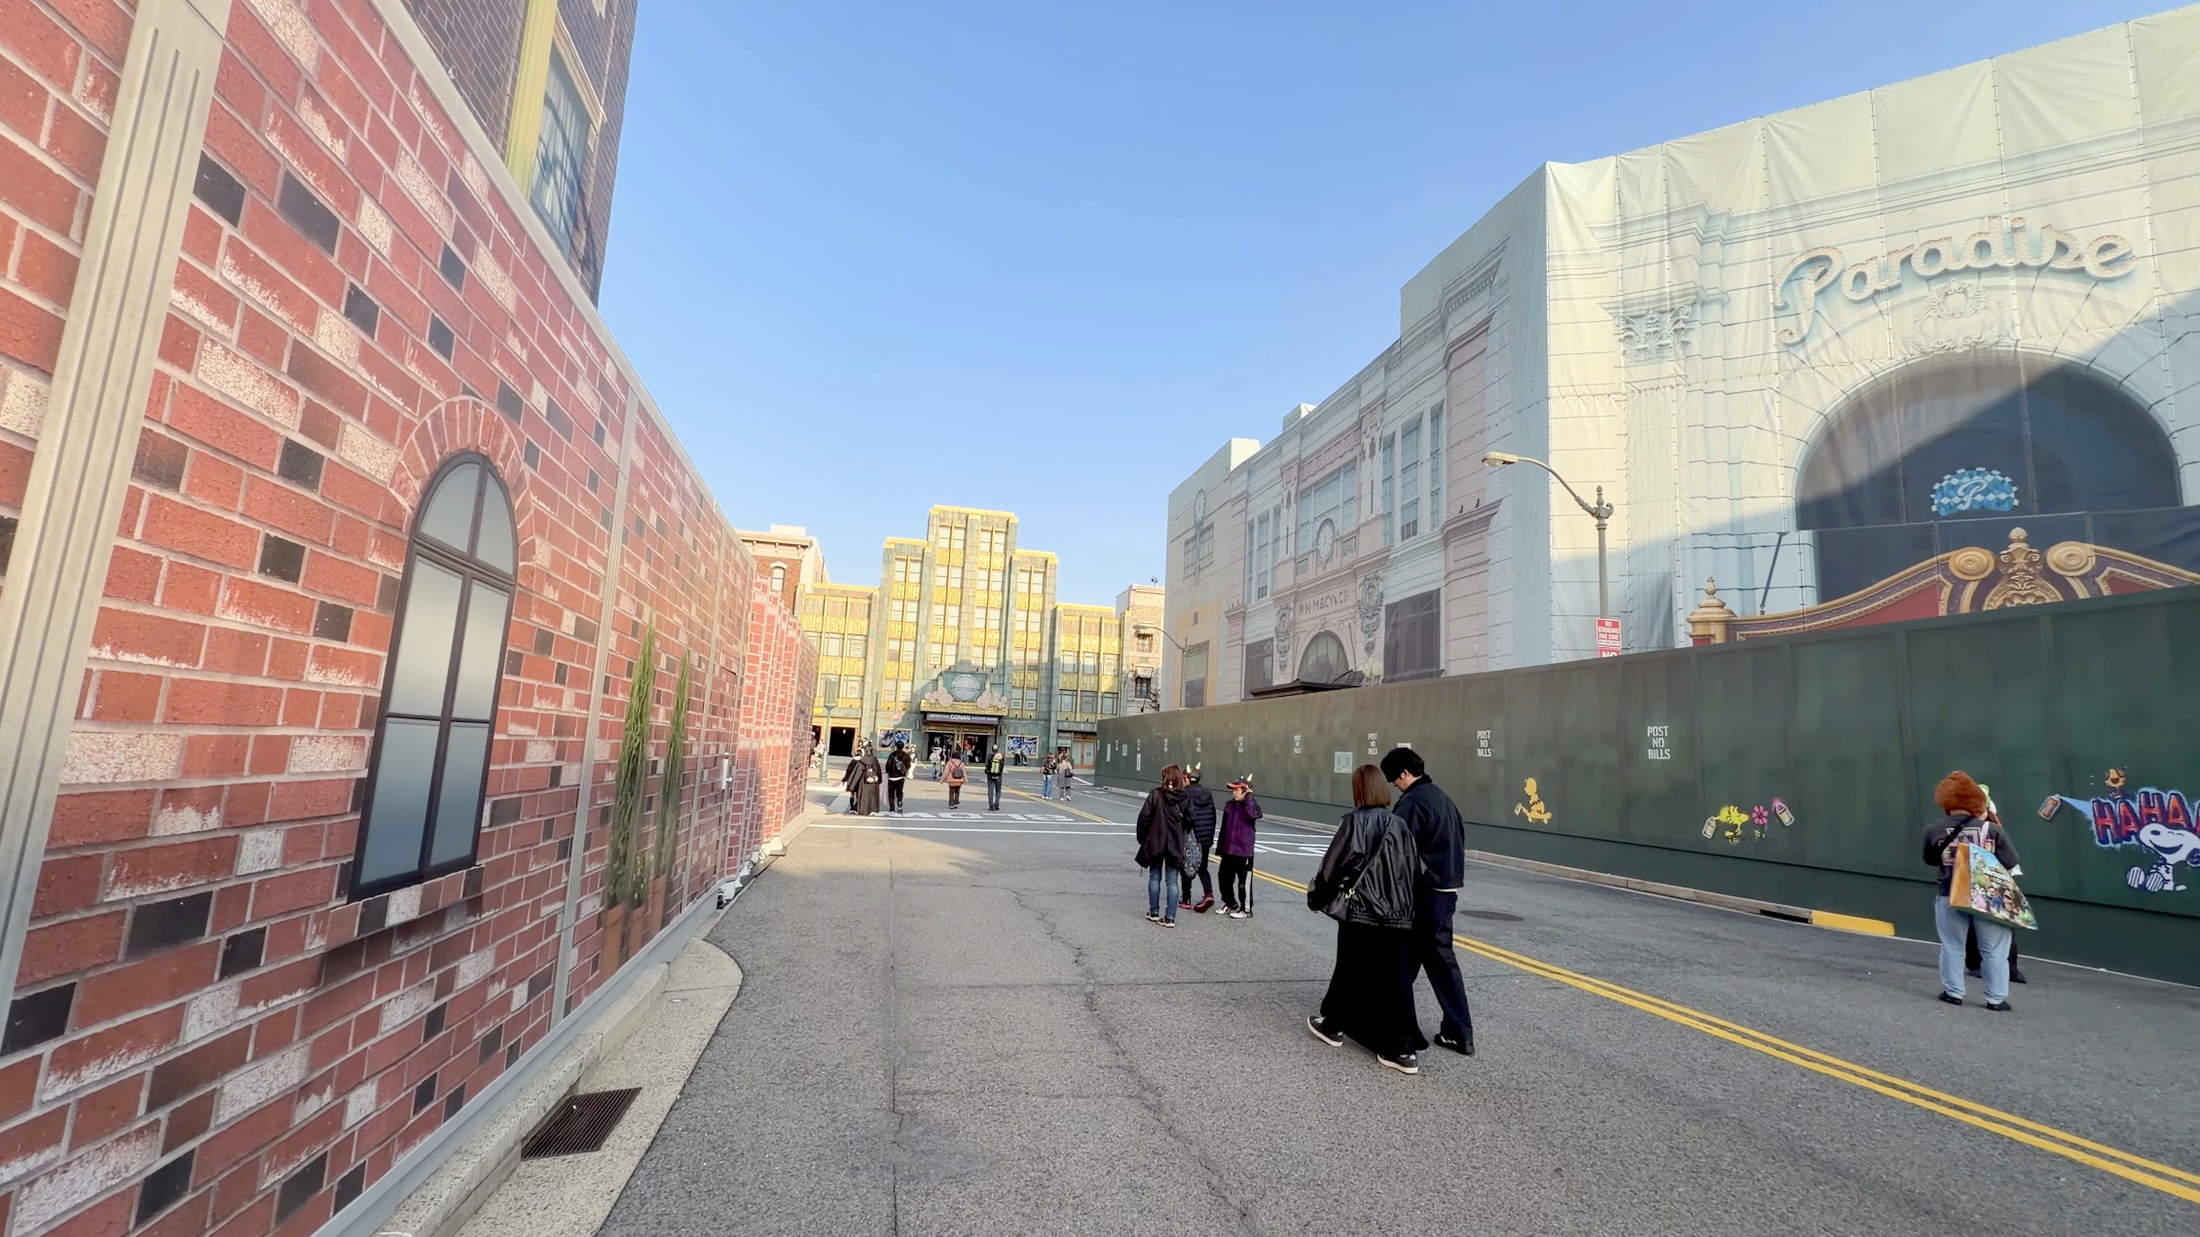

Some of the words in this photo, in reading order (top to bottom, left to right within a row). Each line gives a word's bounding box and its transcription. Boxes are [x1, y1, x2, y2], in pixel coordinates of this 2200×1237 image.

[1774, 216, 2138, 346] Paradise
[1477, 730, 1491, 739] POST
[1647, 725, 1669, 737] POST
[1479, 739, 1489, 748] NO
[1652, 737, 1665, 748] NO
[1477, 748, 1492, 757] BILLS
[1648, 748, 1671, 760] BILLS
[2092, 791, 2200, 845] HAHA
